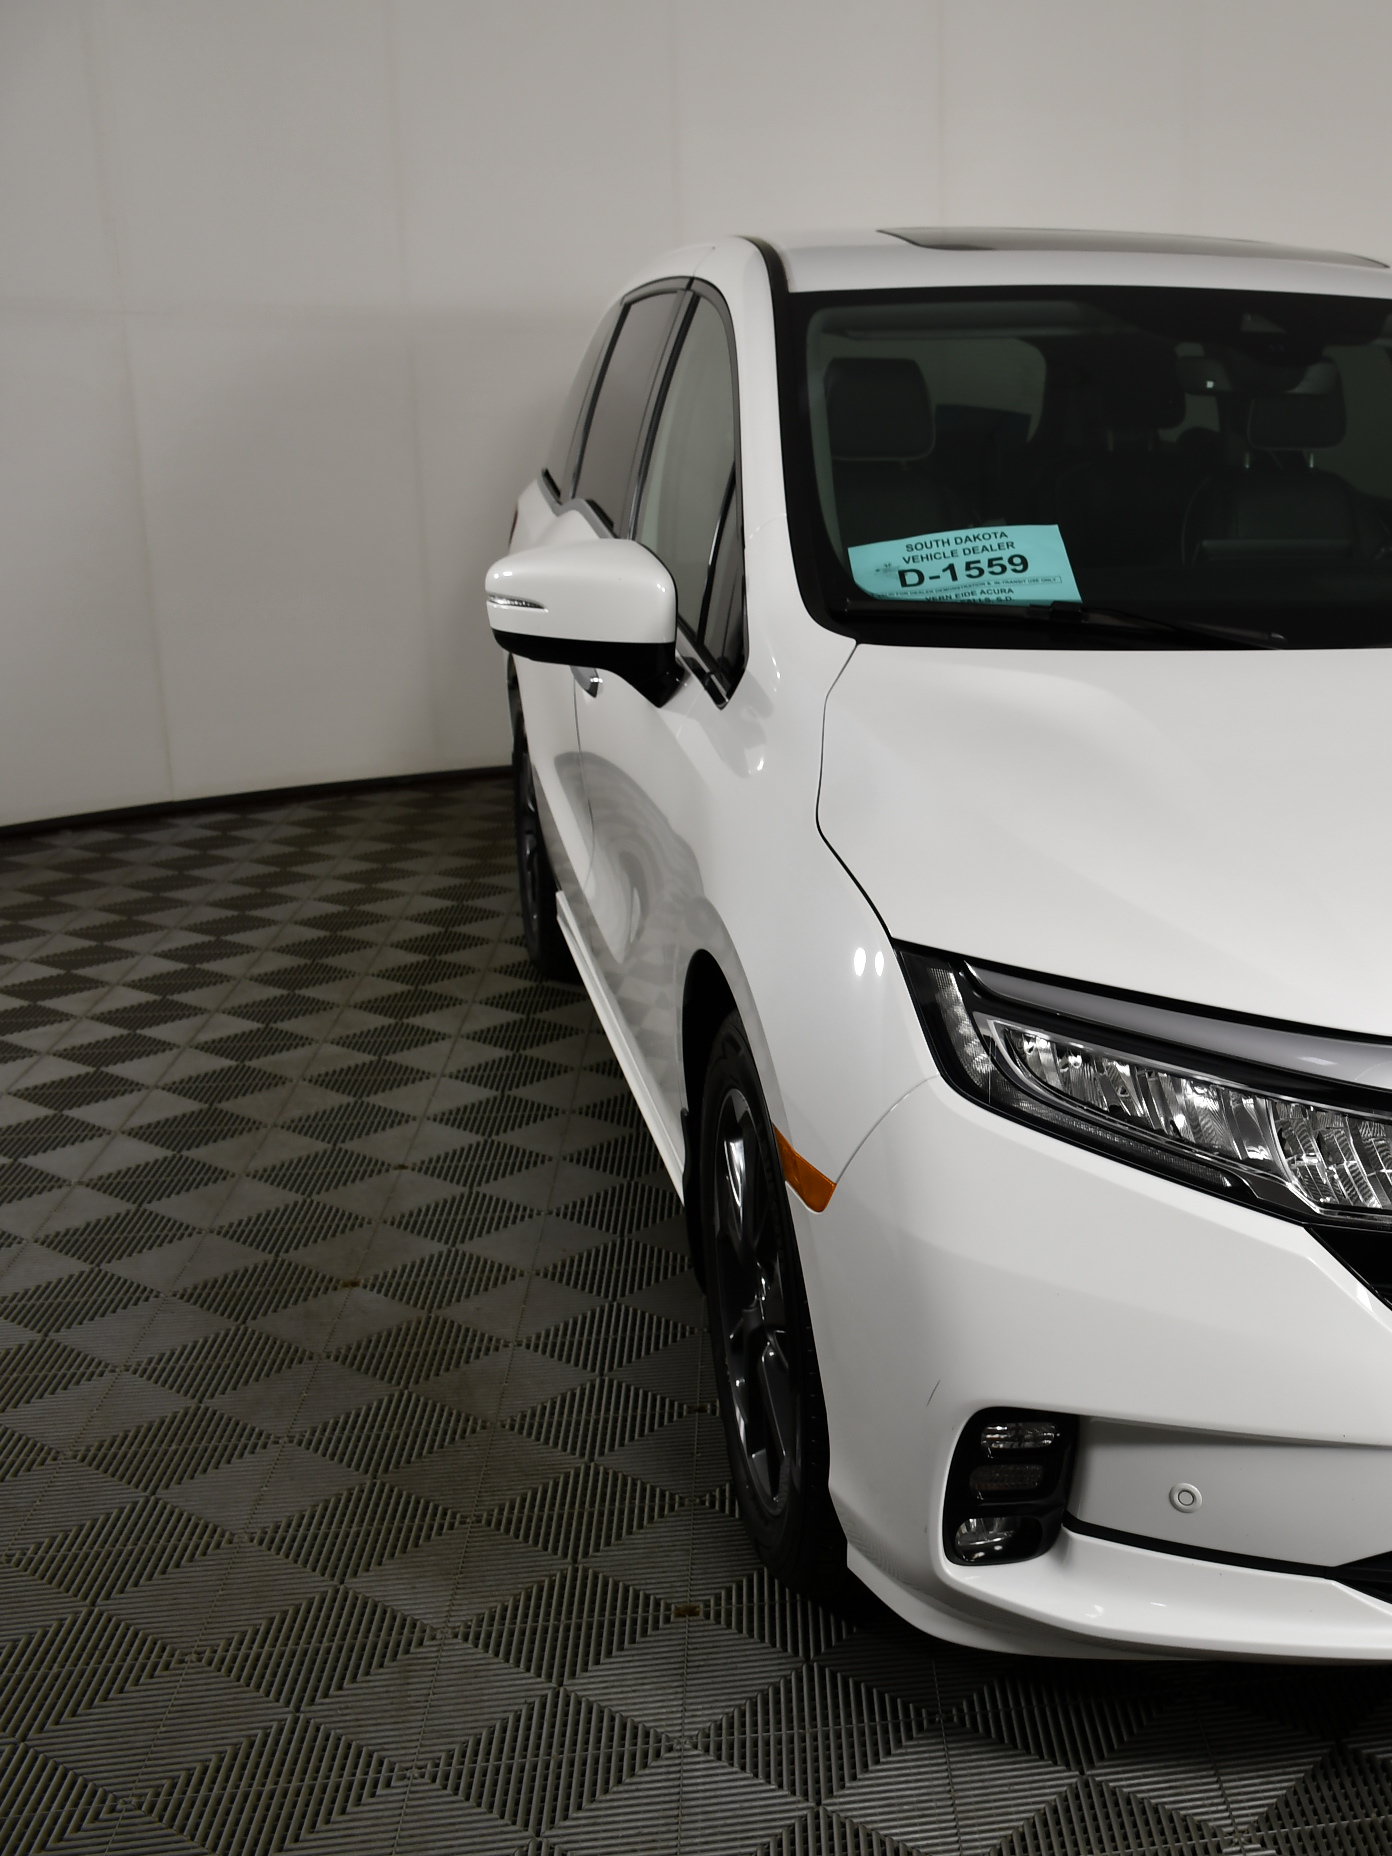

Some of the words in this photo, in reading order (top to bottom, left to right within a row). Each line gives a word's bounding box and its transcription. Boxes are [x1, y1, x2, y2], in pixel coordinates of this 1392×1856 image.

[905, 538, 951, 552] SOUTH
[954, 531, 1009, 545] DAKOTA
[902, 550, 960, 565] VEHICLE
[962, 541, 1016, 556] DEALER
[898, 554, 1029, 588] D-1559
[954, 590, 977, 599] EIDE
[979, 587, 1015, 596] ACURA
